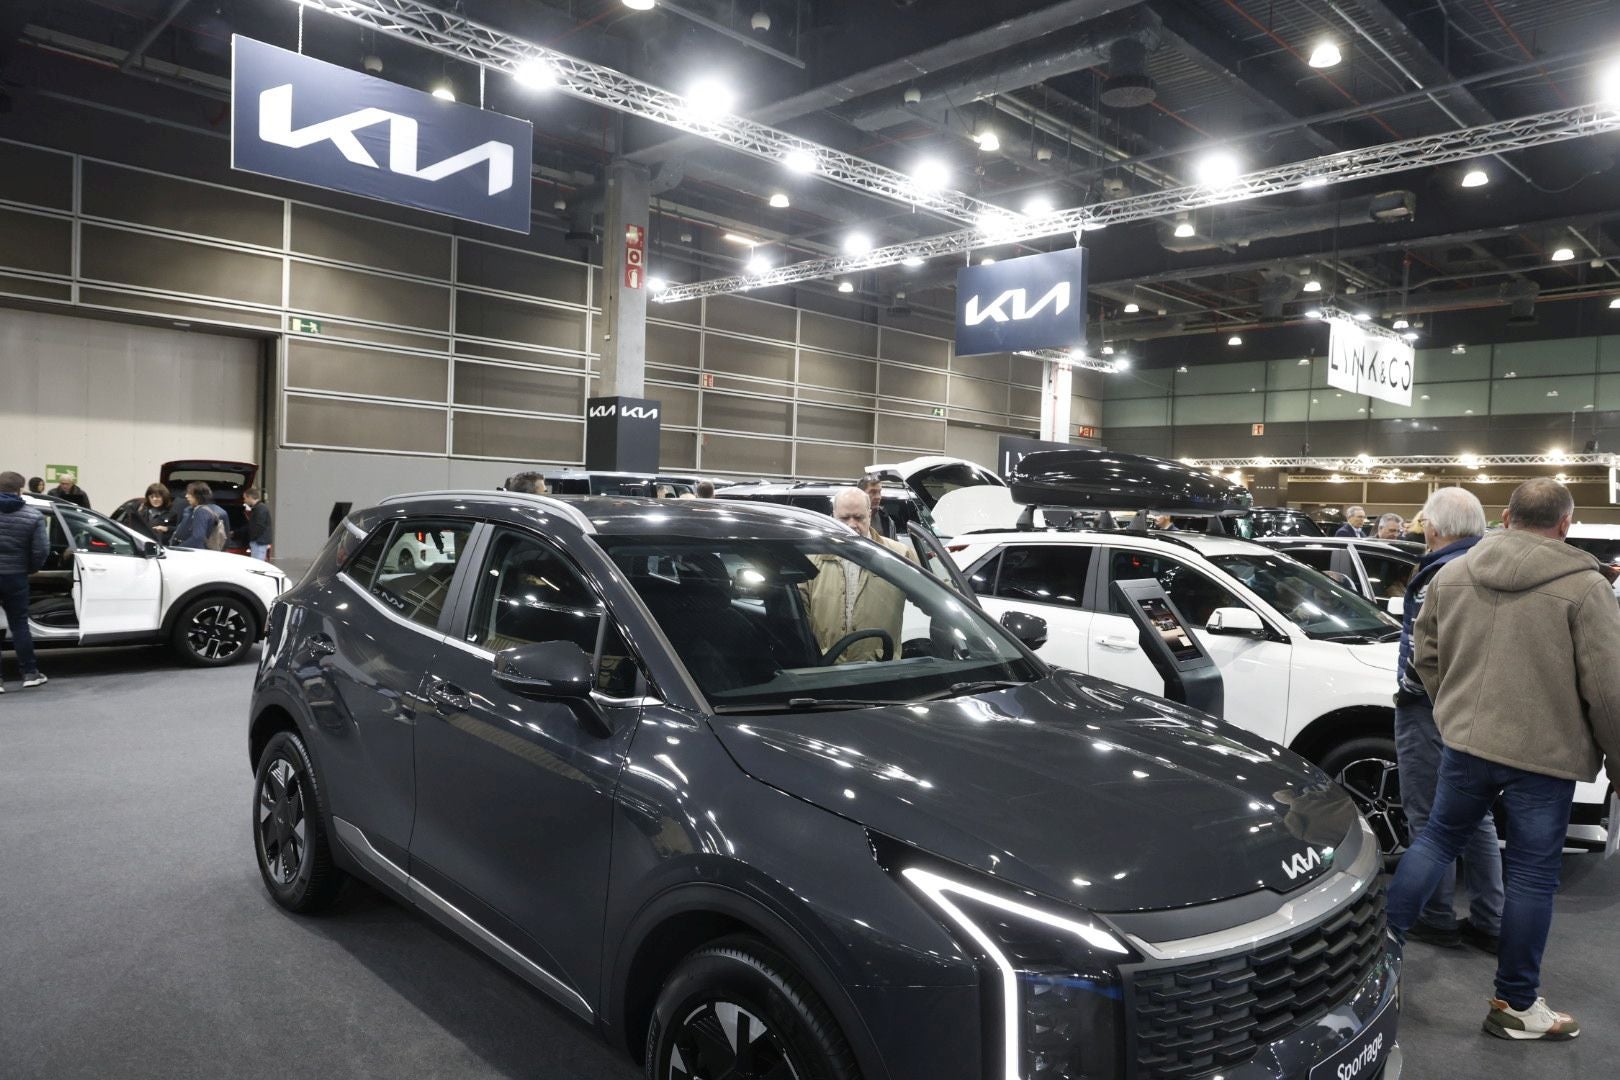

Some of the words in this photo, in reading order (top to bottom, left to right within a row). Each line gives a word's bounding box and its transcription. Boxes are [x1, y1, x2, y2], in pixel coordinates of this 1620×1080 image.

[258, 83, 514, 196] KIA
[965, 281, 1071, 327] KIA
[1336, 1031, 1384, 1080] Sportage
